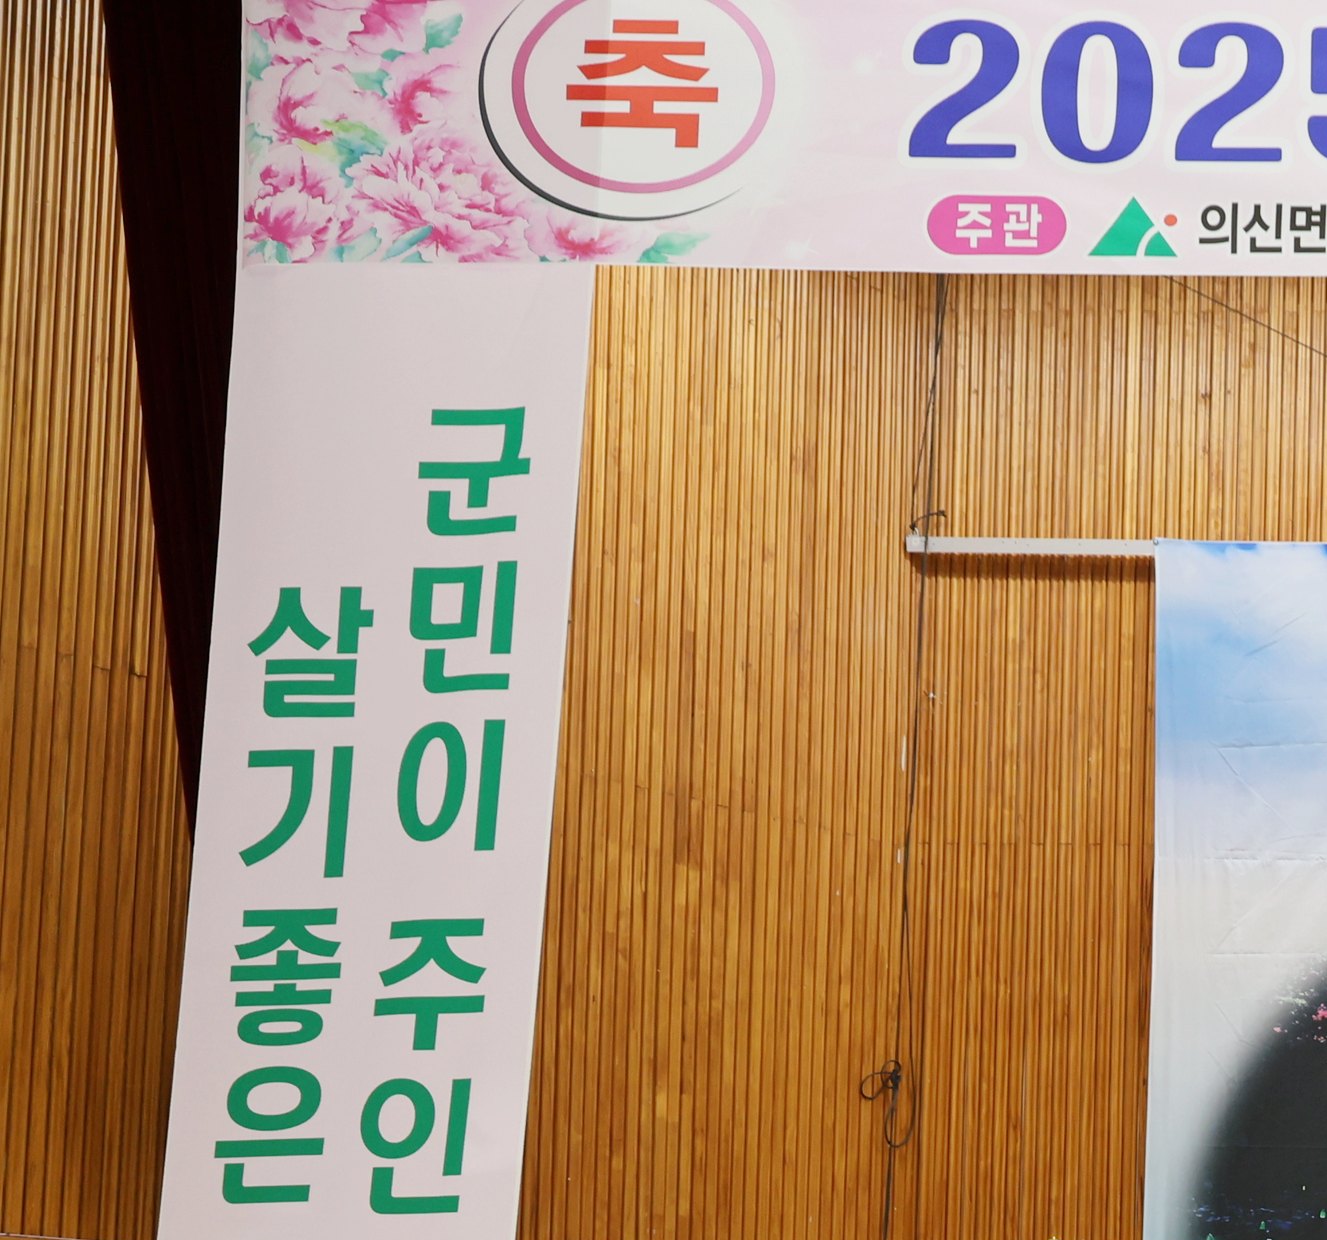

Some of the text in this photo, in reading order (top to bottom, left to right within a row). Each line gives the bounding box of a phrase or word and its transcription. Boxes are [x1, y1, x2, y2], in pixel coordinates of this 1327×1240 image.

[564, 19, 719, 150] 축
[954, 205, 1044, 250] 주관
[397, 406, 532, 852] 군민이
[214, 586, 375, 1204] 살기좋은
[361, 918, 487, 1215] 주인
